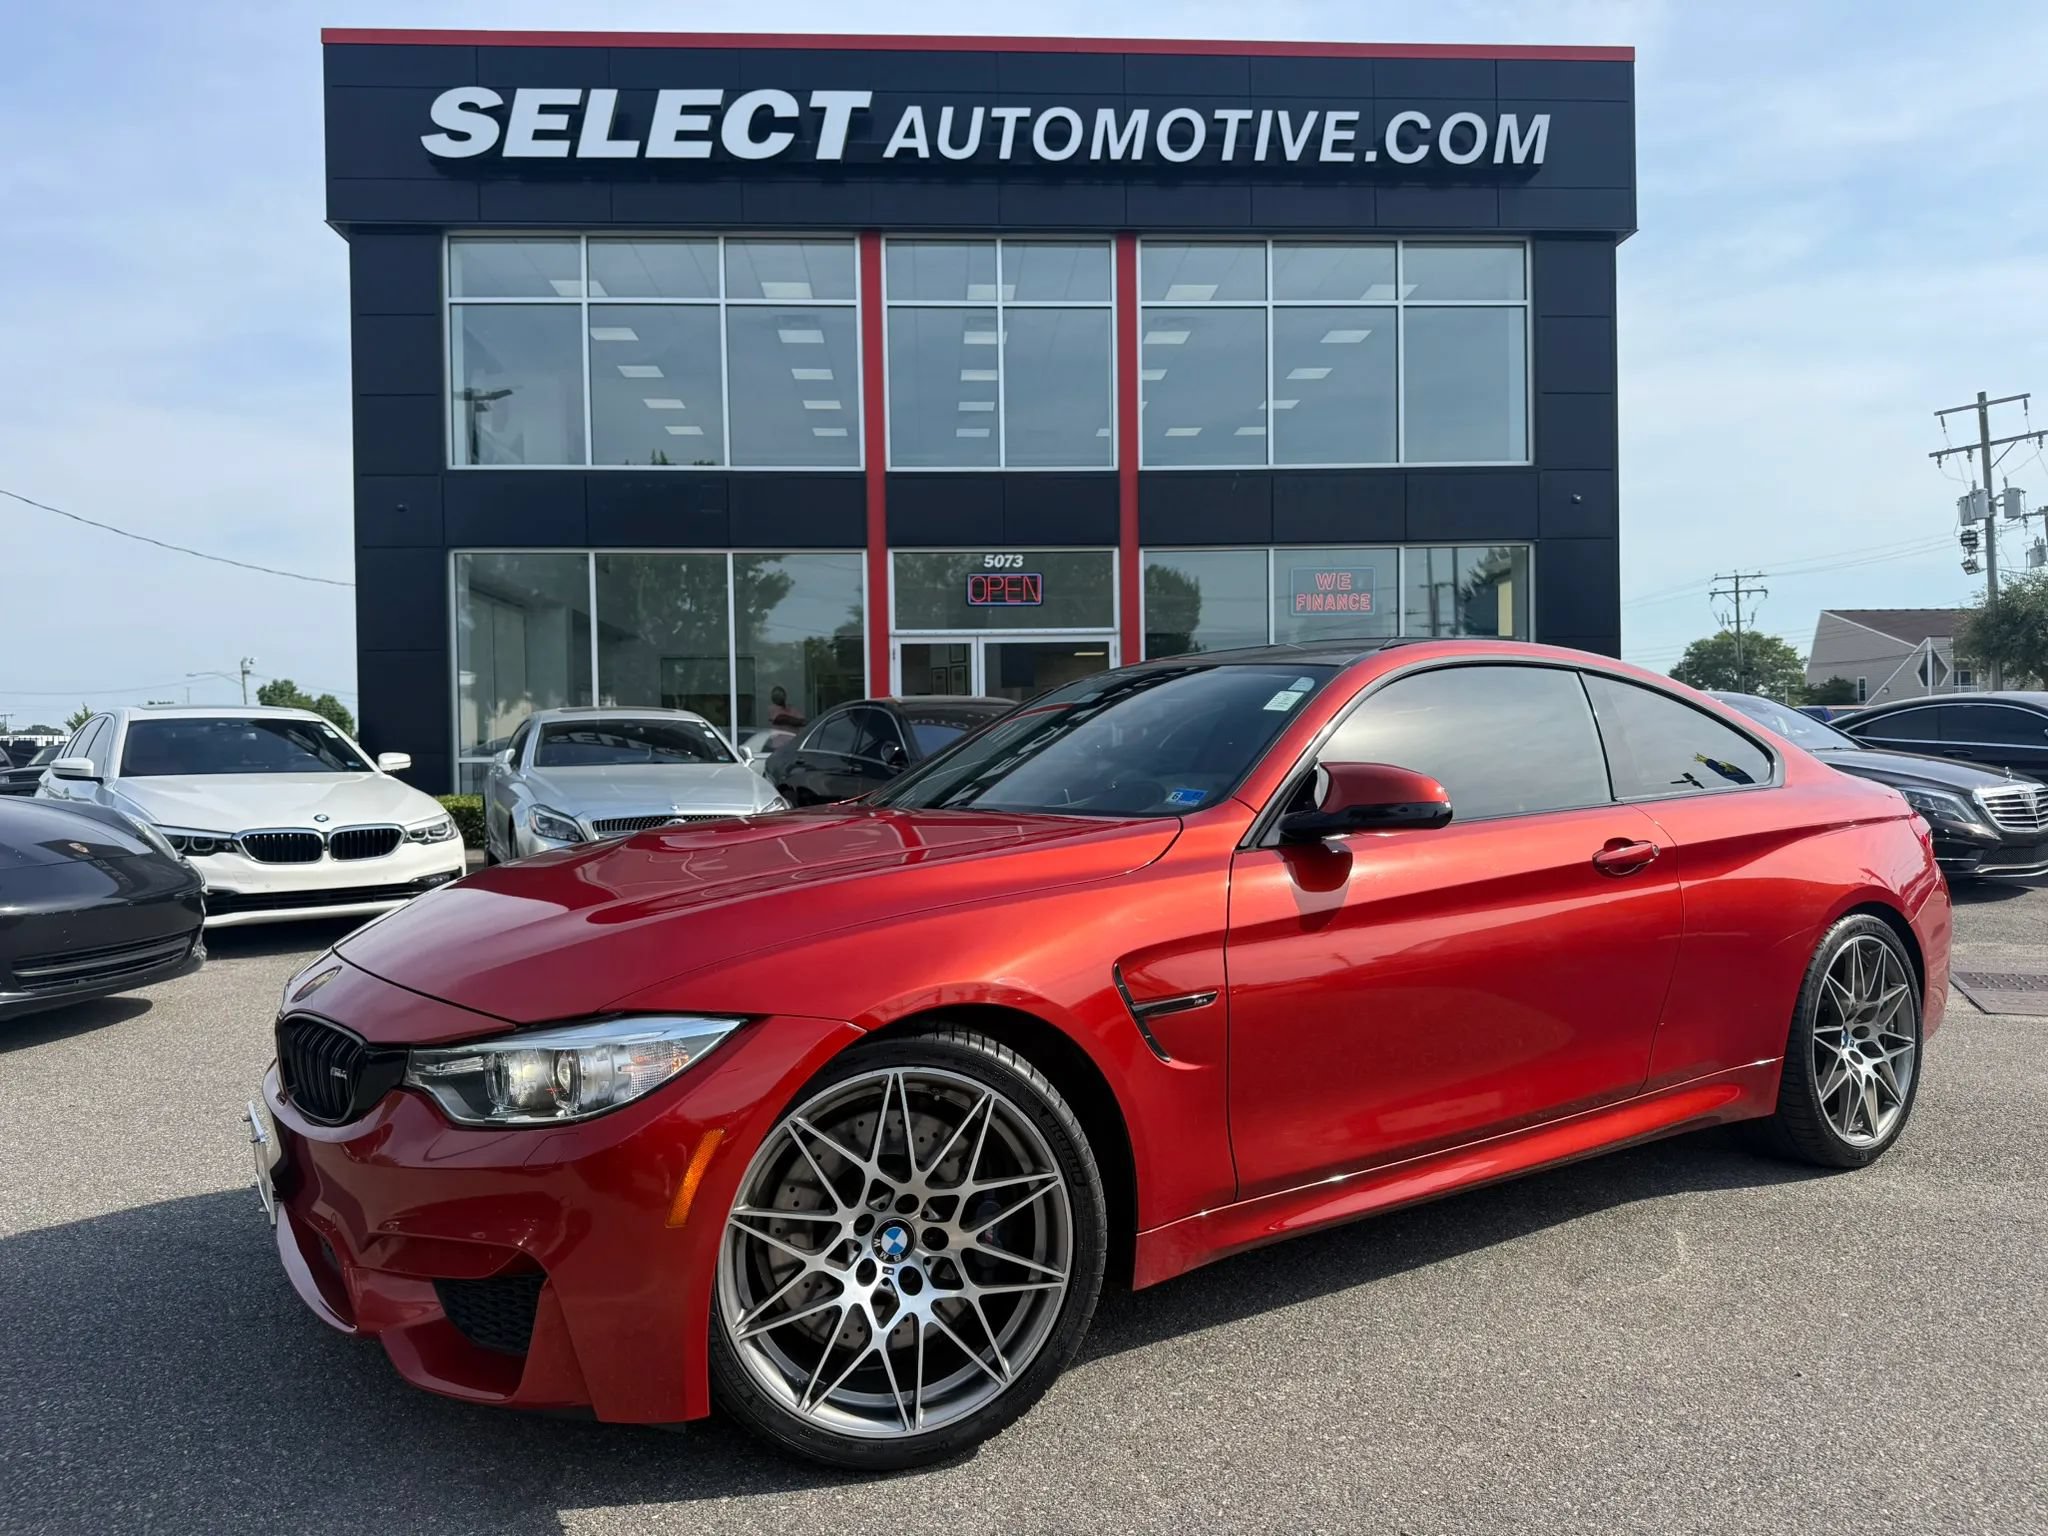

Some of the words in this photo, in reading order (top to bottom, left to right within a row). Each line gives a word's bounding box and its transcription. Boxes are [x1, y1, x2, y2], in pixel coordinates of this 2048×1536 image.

[420, 86, 873, 161] SELECT
[882, 105, 1551, 166] AUTOMOTIVE.COM
[983, 554, 1024, 568] 5073
[970, 575, 1040, 603] OPEN
[1315, 572, 1352, 591] WE
[1296, 593, 1371, 611] FINANCE
[873, 1238, 902, 1262] BMW
